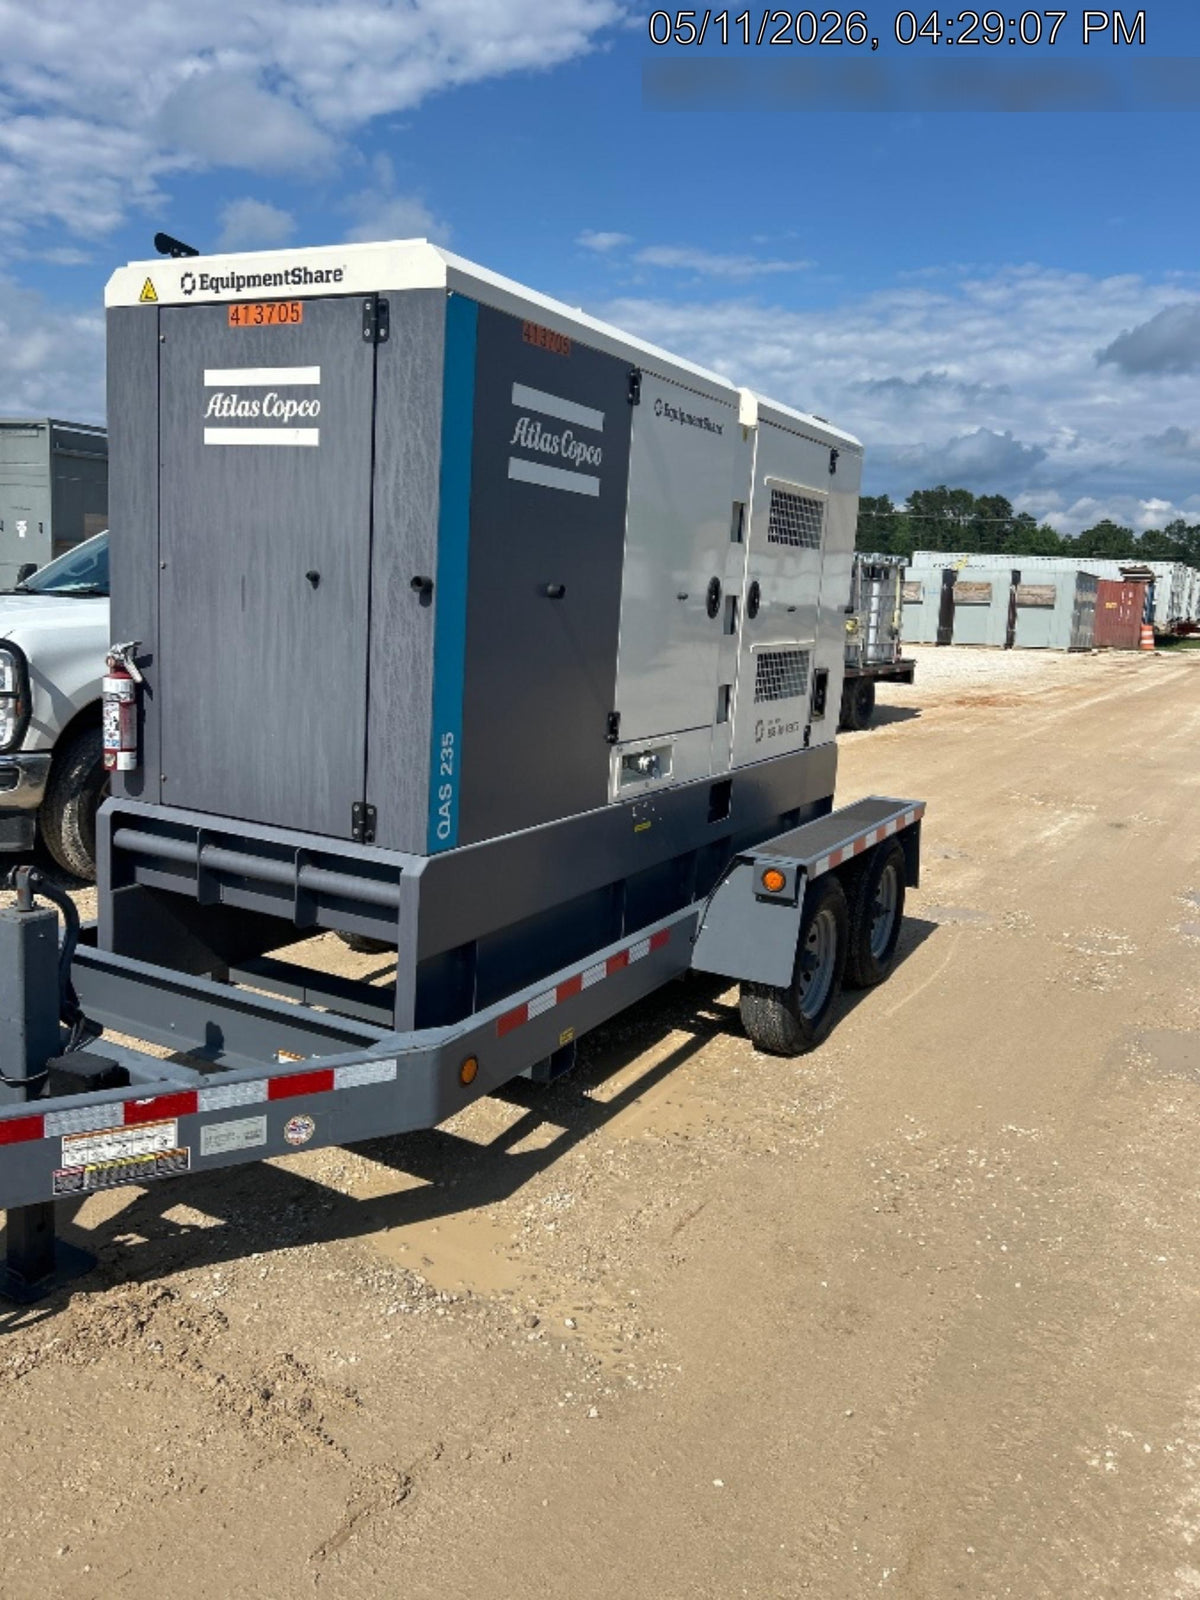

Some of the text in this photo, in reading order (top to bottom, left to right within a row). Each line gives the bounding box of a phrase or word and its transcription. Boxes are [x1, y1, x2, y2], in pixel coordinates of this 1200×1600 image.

[199, 267, 344, 293] EquipmentShare
[230, 302, 301, 325] 413705
[204, 392, 321, 423] Atlas Copco
[510, 416, 602, 466] Atlas Copco
[437, 731, 454, 840] QAS 235
